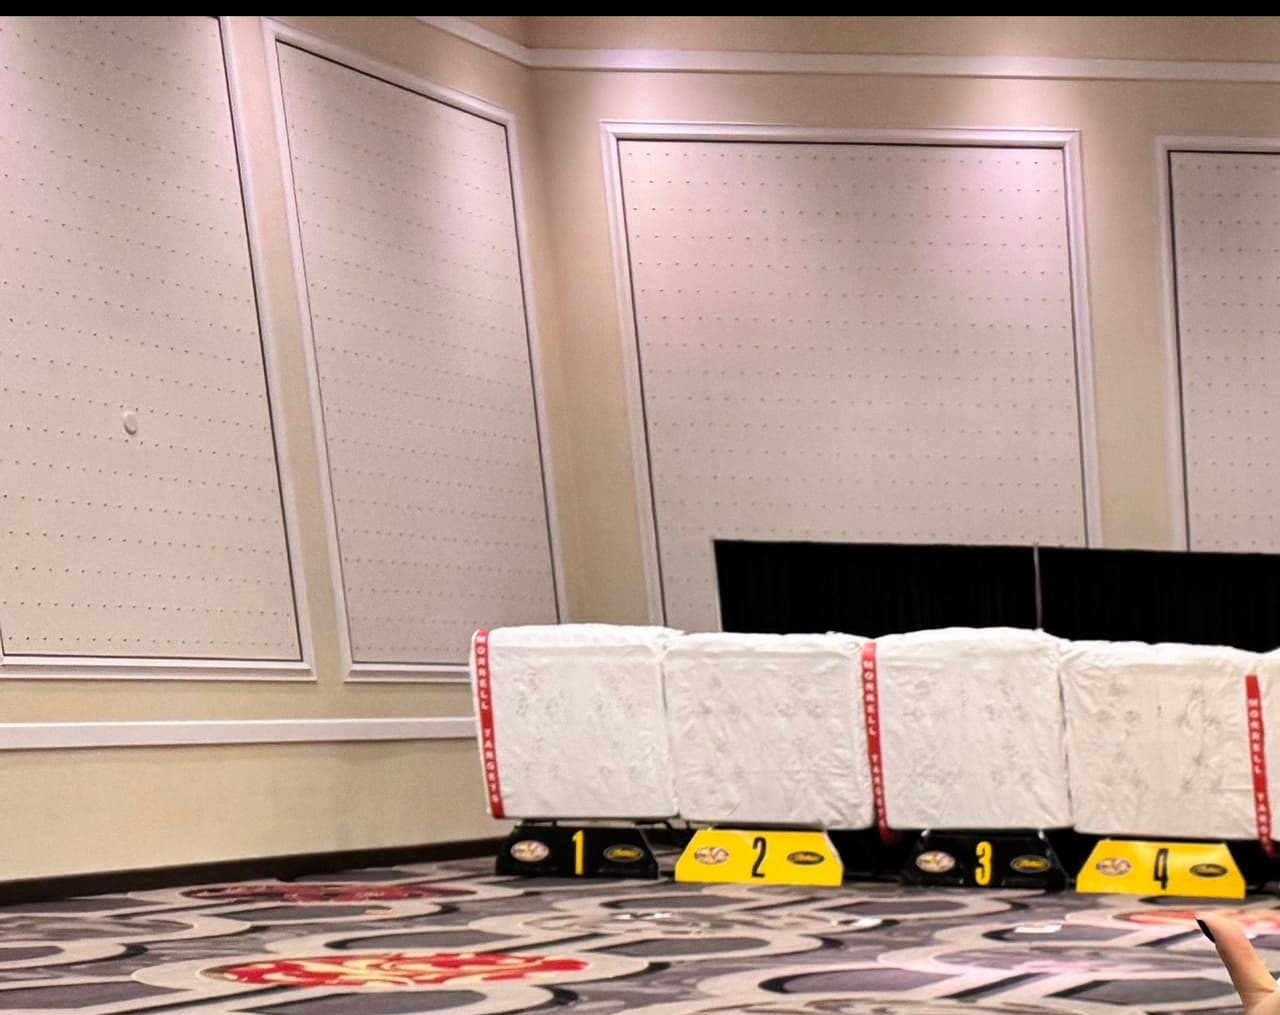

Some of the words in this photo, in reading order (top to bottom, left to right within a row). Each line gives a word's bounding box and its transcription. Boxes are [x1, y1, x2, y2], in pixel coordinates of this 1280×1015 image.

[476, 634, 489, 710] MORRELL
[483, 729, 500, 804] TARGETS
[863, 660, 877, 736] MORRELL
[1247, 698, 1262, 774] MORRELL
[572, 829, 585, 876] 1
[751, 836, 767, 878] 2
[974, 840, 992, 886] 3
[1153, 848, 1169, 890] 4
